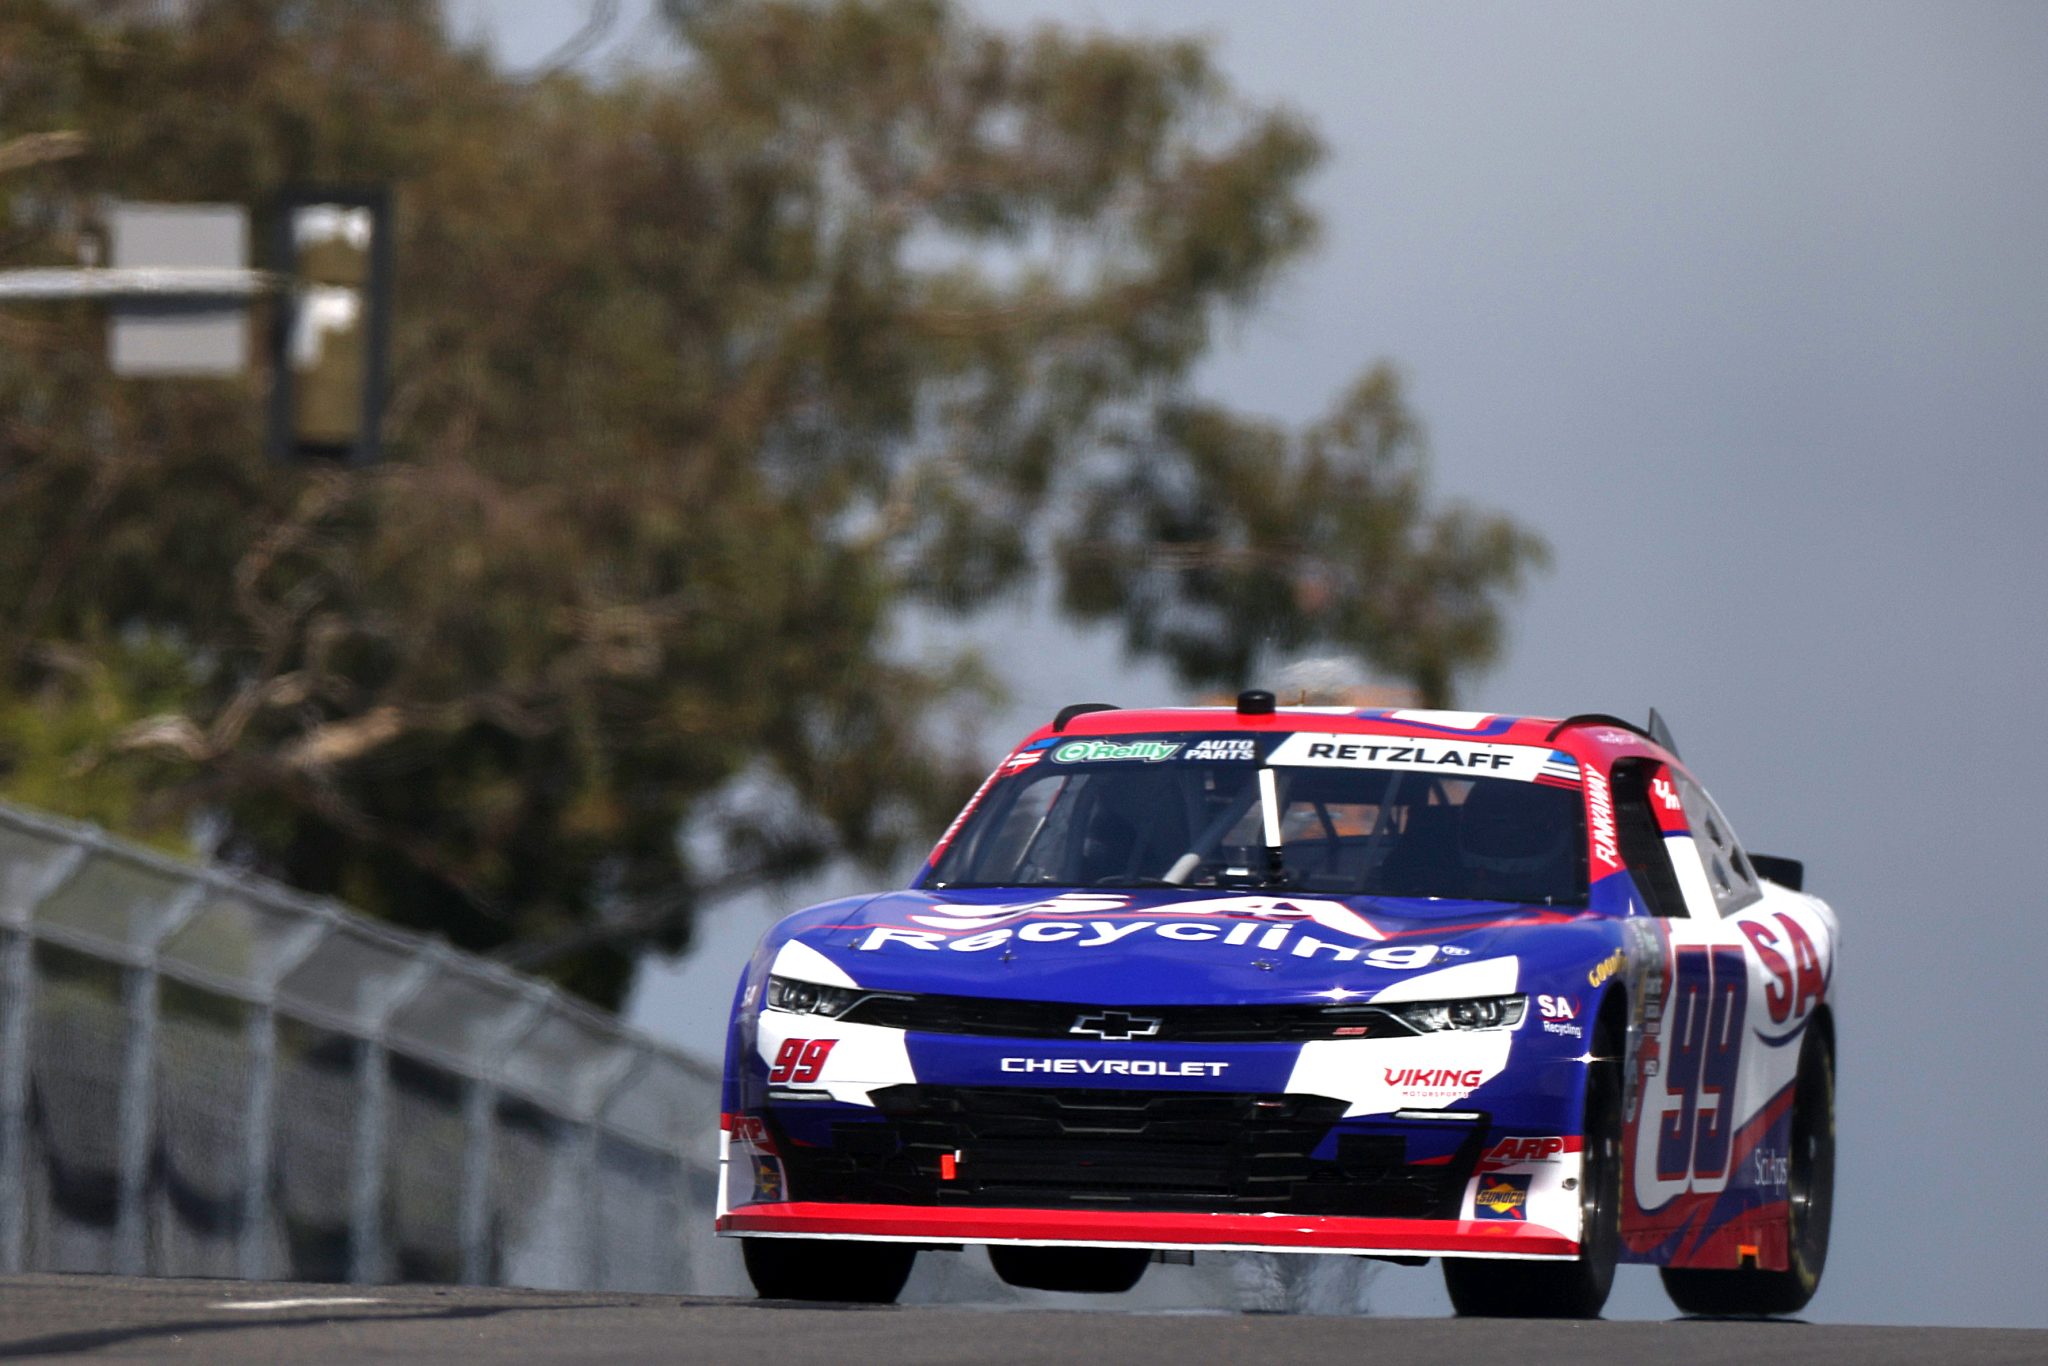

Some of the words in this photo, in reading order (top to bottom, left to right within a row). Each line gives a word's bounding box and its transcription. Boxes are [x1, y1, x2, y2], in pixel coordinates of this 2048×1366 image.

[1184, 749, 1254, 760] PARTS
[1196, 740, 1255, 750] AUTO
[1308, 742, 1513, 769] RETZLAFF
[1585, 762, 1619, 868] FUNKAWAY
[1738, 912, 1824, 1024] SA
[1538, 995, 1574, 1019] SA
[1543, 1021, 1582, 1038] Recycling
[768, 1038, 839, 1084] 99
[1001, 1057, 1229, 1077] CHEVROLET
[1657, 944, 1748, 1182] 99
[1384, 1067, 1482, 1087] VIKING
[1488, 1137, 1564, 1160] ARP
[1478, 1191, 1523, 1205] SUNOCO
